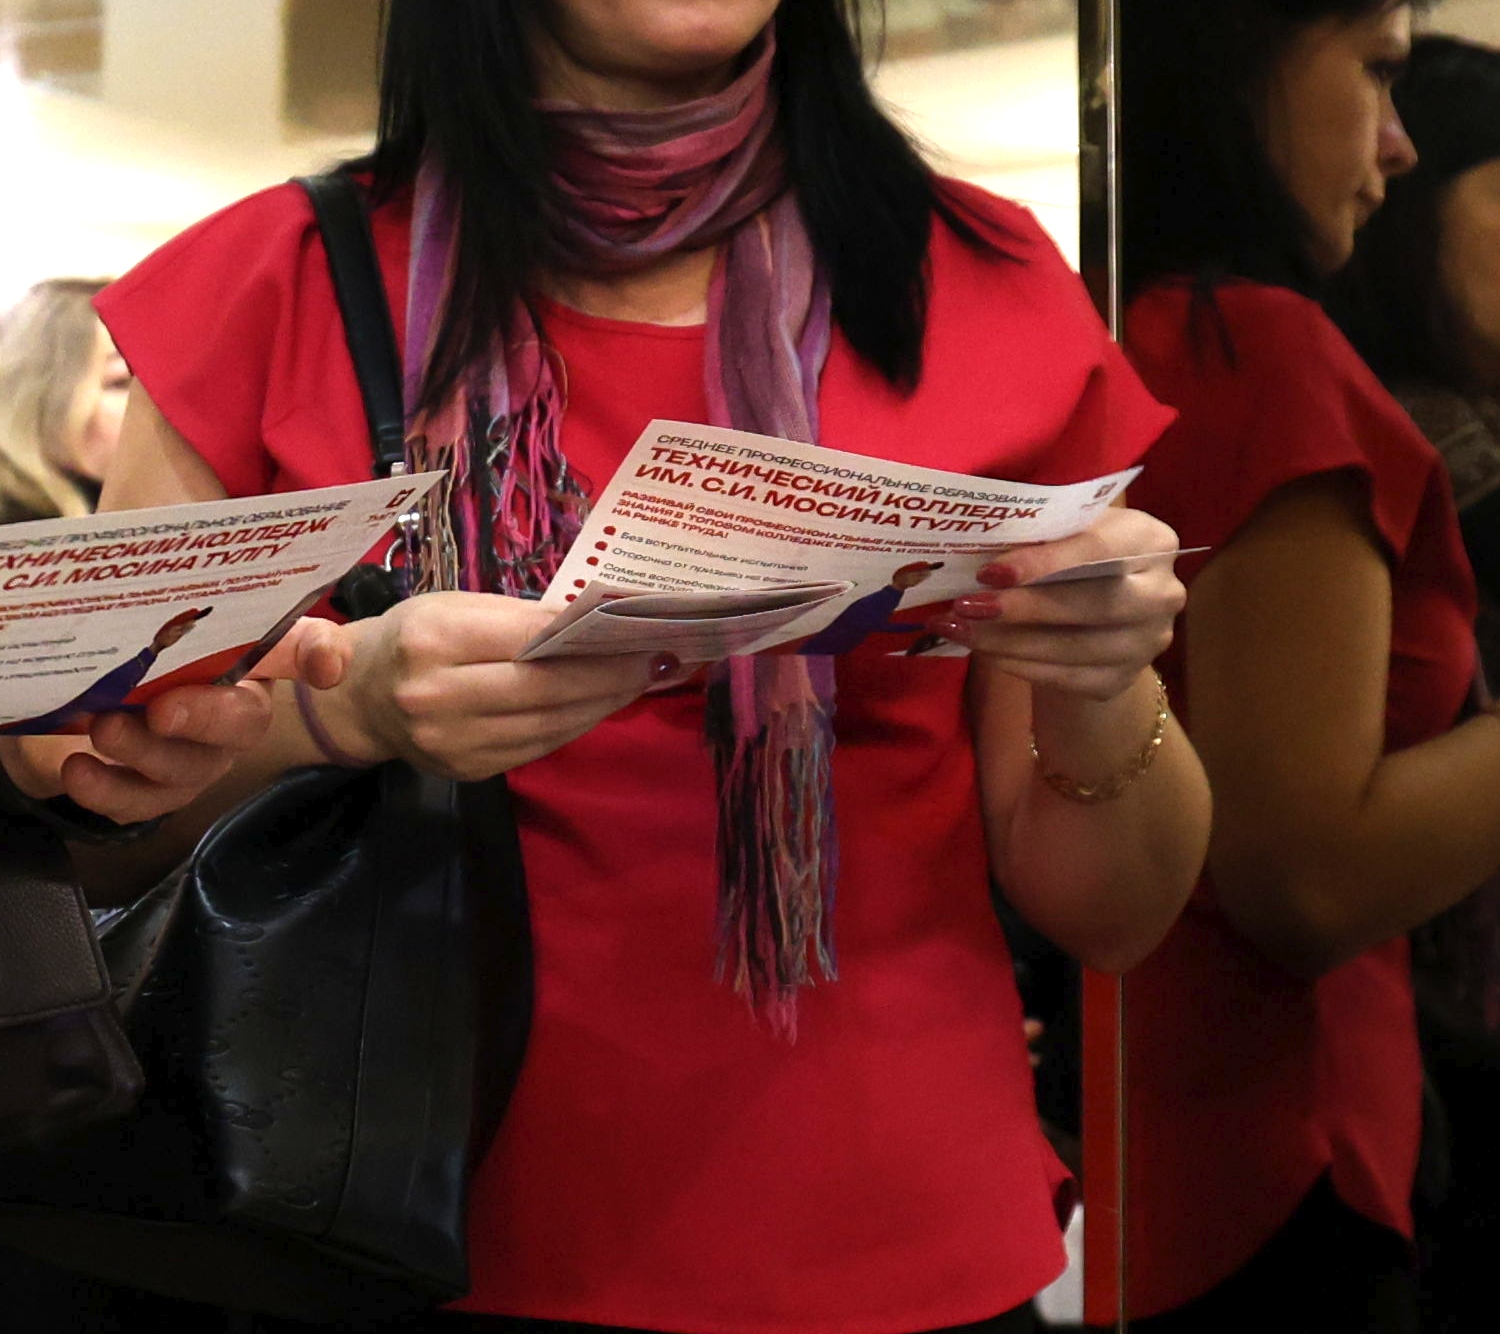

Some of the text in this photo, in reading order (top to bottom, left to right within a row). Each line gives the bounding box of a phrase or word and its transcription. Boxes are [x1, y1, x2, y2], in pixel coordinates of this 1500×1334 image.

[650, 446, 1044, 520] ТЕХНИЧЕСКИЙ КОЛЛЕДЖ
[657, 435, 1050, 505] СРЕДНЕЕ ПРОФЕССИОНАЛЬНОЕ ОБРАЗОВАНИЕ
[617, 499, 673, 518] ЗНАНИЯ
[689, 514, 755, 534] ТОПОВОМ
[635, 464, 1003, 533] ИМ. С.И. МОСИНА ТУЛГУ
[191, 515, 338, 549] КОЛЛЕДЖ
[611, 507, 729, 539] НА РЫНКЕ ТРУДА!
[620, 531, 643, 543] Без
[3, 570, 61, 590] С.И.
[63, 555, 198, 584] МОСИНА
[201, 542, 292, 568] ТУЛГУ
